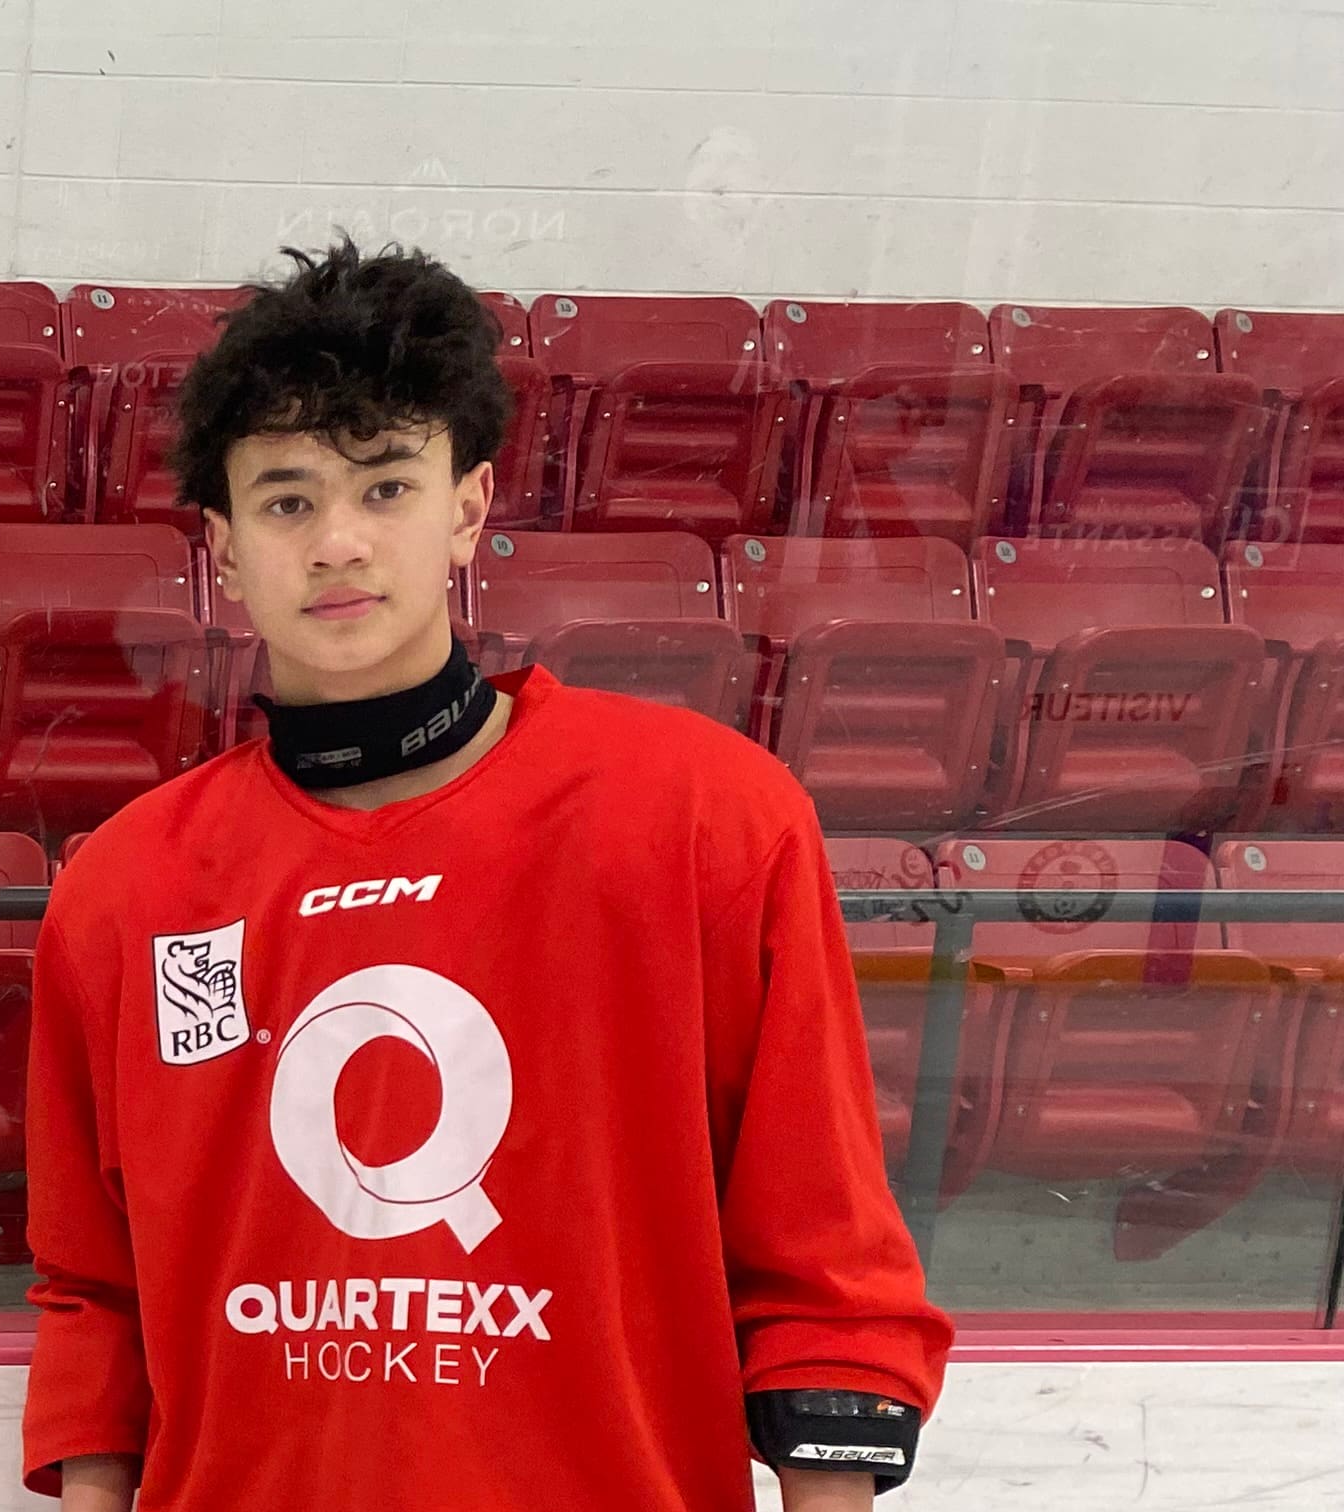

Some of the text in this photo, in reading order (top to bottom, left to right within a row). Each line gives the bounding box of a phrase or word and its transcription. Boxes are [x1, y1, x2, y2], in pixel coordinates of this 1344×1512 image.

[298, 874, 442, 918] CCM
[172, 1012, 241, 1057] RBC
[224, 1277, 553, 1341] QUARTEXX
[284, 1340, 502, 1387] HOCKEY
